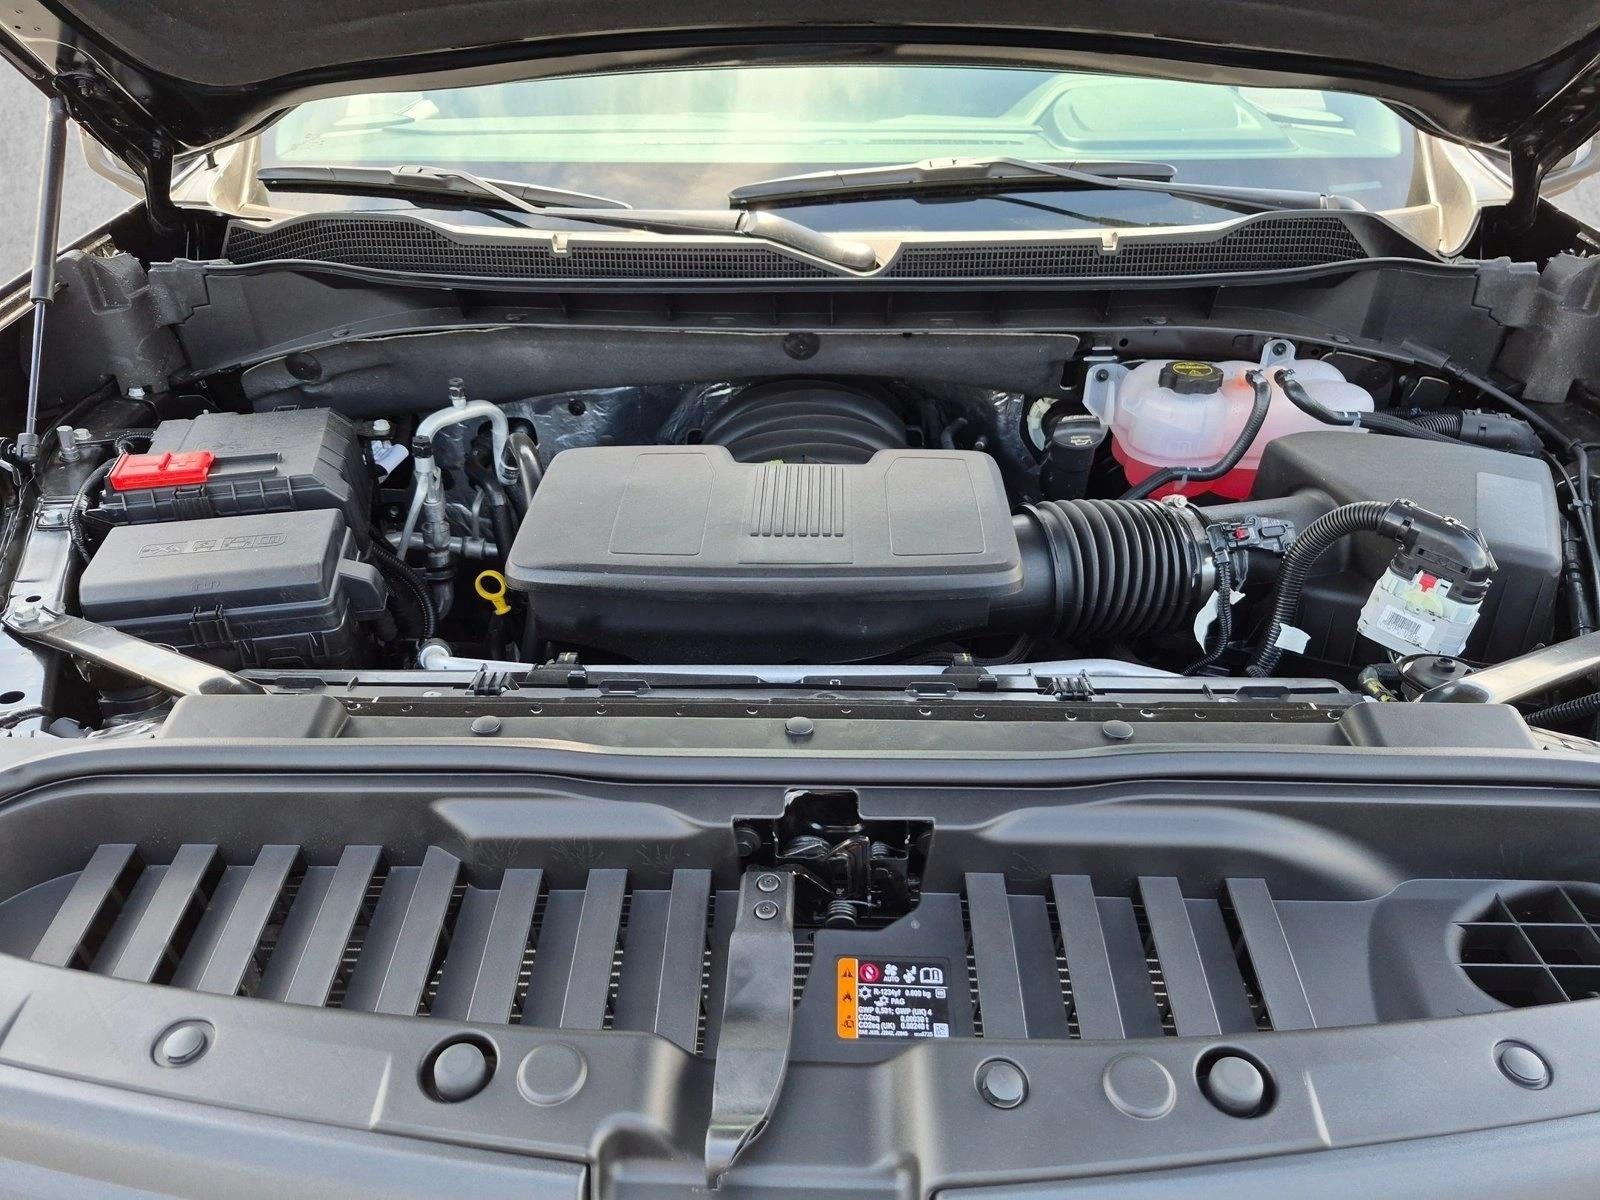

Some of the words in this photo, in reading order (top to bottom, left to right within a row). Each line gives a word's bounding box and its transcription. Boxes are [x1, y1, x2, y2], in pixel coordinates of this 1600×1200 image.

[874, 988, 901, 997] R-1234yf
[923, 990, 932, 998] kg
[912, 1008, 926, 1016] (UK)
[858, 1014, 880, 1022] CO2eq
[858, 1022, 880, 1030] CO2eq
[881, 1022, 895, 1030] (UK)
